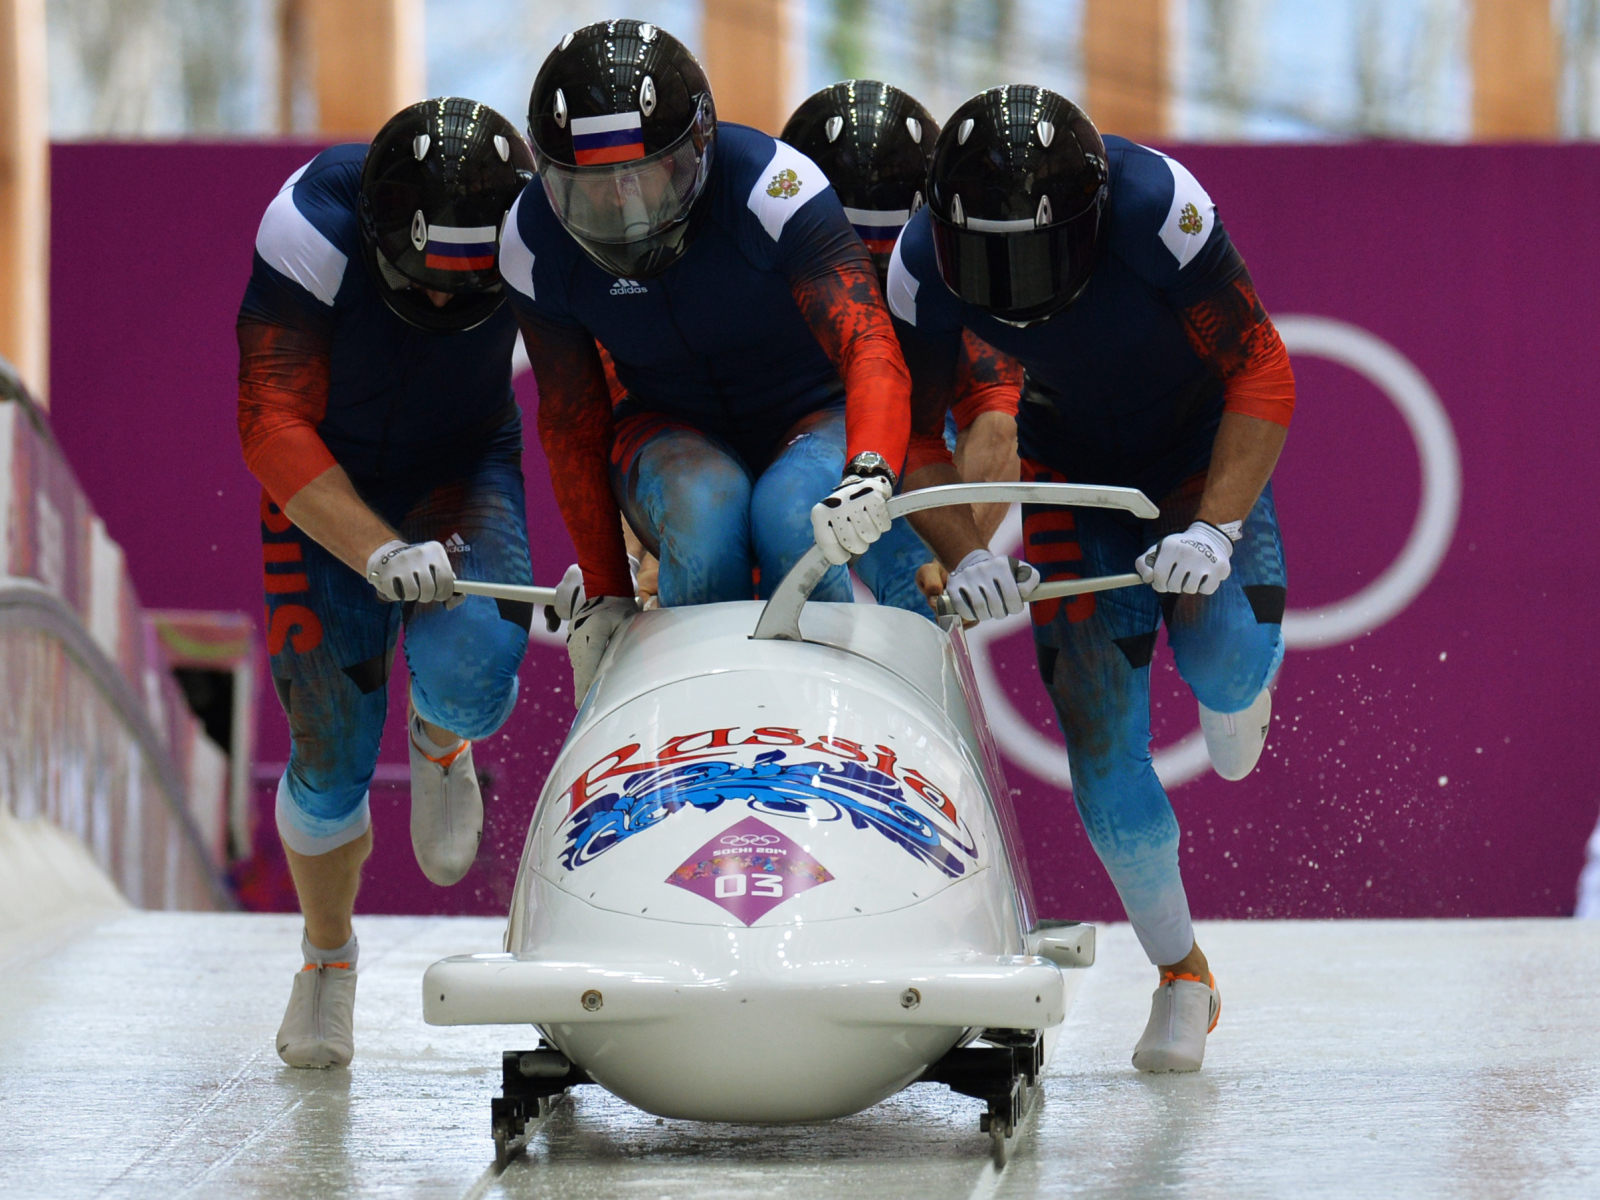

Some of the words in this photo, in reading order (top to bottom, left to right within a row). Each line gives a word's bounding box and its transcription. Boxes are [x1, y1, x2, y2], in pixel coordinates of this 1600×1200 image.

[609, 286, 648, 296] adidas
[553, 726, 960, 836] Russia
[712, 847, 753, 857] SOCHI
[756, 846, 787, 855] 2014
[714, 873, 784, 899] 03
